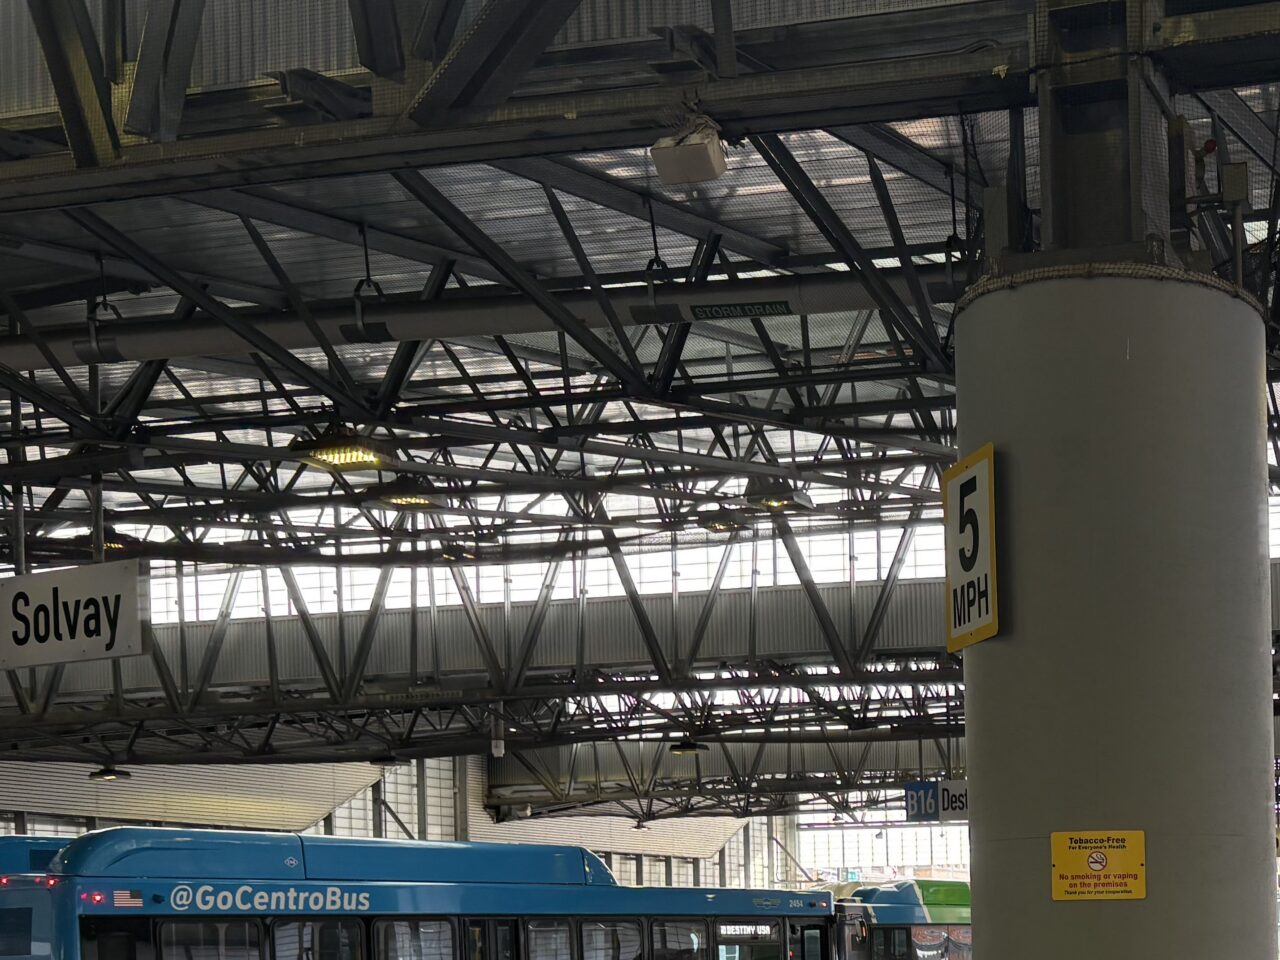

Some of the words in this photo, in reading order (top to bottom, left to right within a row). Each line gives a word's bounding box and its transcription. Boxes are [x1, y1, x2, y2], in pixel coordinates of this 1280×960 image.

[695, 306, 744, 318] STORM
[745, 304, 788, 316] DRAIN
[959, 475, 979, 573] 5
[953, 573, 989, 629] MPH
[12, 586, 121, 652] Solvay
[907, 788, 935, 815] B16
[1068, 836, 1126, 844] Tobacco-Free
[1070, 873, 1101, 881] smoking
[1113, 872, 1138, 881] vaping
[1093, 881, 1128, 889] premises
[170, 885, 370, 911] @GoCentroBus
[727, 925, 755, 935] DESTINY
[756, 925, 770, 935] USA
